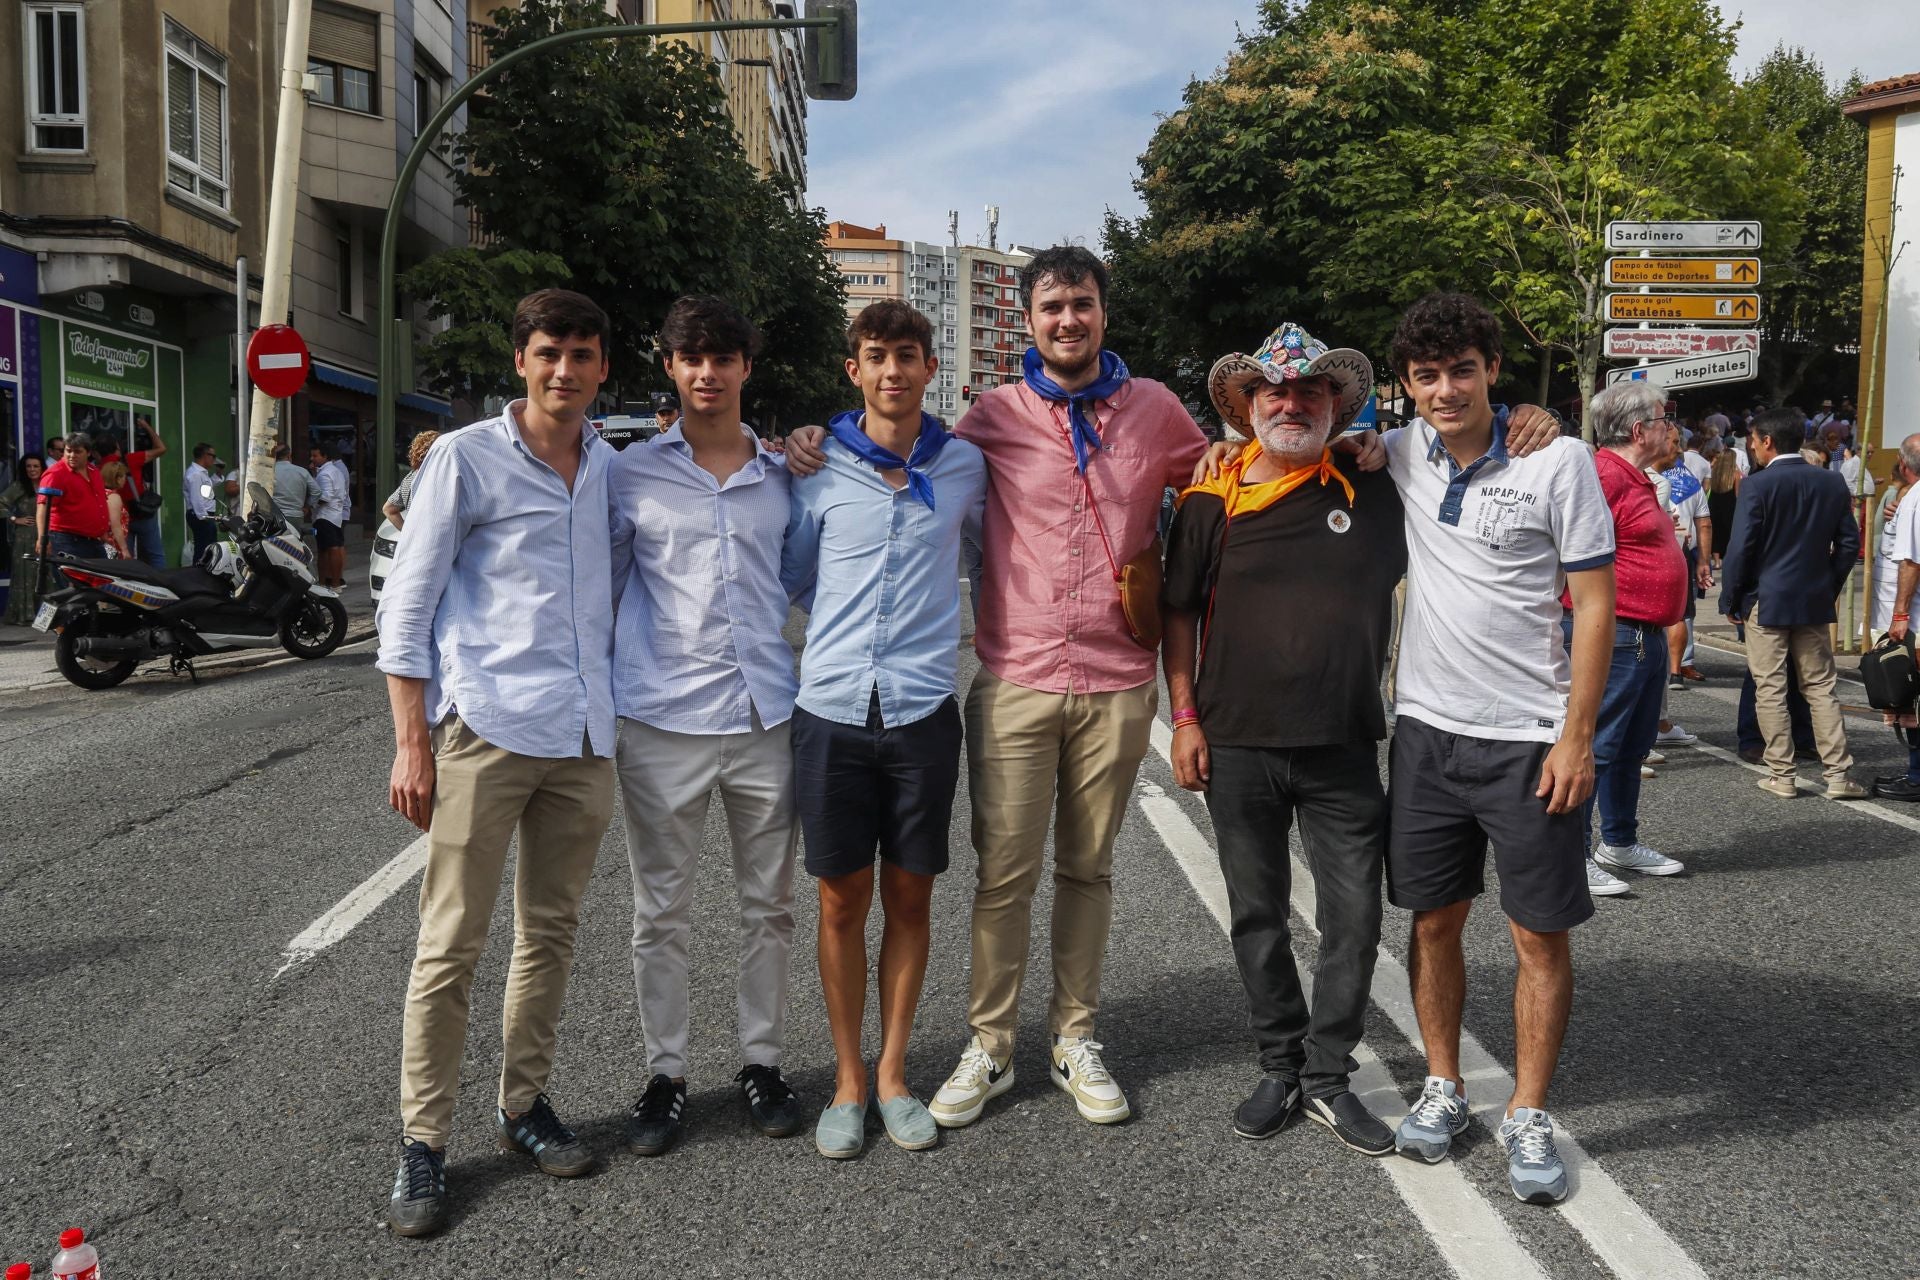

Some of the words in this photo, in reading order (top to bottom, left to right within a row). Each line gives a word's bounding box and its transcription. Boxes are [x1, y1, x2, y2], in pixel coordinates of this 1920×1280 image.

[1615, 230, 1684, 241] Sardinero
[1657, 261, 1682, 269] fútbol
[1614, 272, 1648, 280] Palacio
[1652, 272, 1664, 280] de
[1667, 272, 1710, 281] Deportes
[1614, 297, 1641, 305] campo
[1656, 297, 1672, 305] golf
[1614, 306, 1682, 317] Mataleñas
[69, 332, 138, 367] Todofarmacia
[108, 361, 123, 374] 24H
[1675, 361, 1746, 379] Hospitales
[67, 376, 117, 392] PARAFARMACIA
[602, 431, 631, 439] CANINOS
[1480, 486, 1537, 506] NAPAPIJRI
